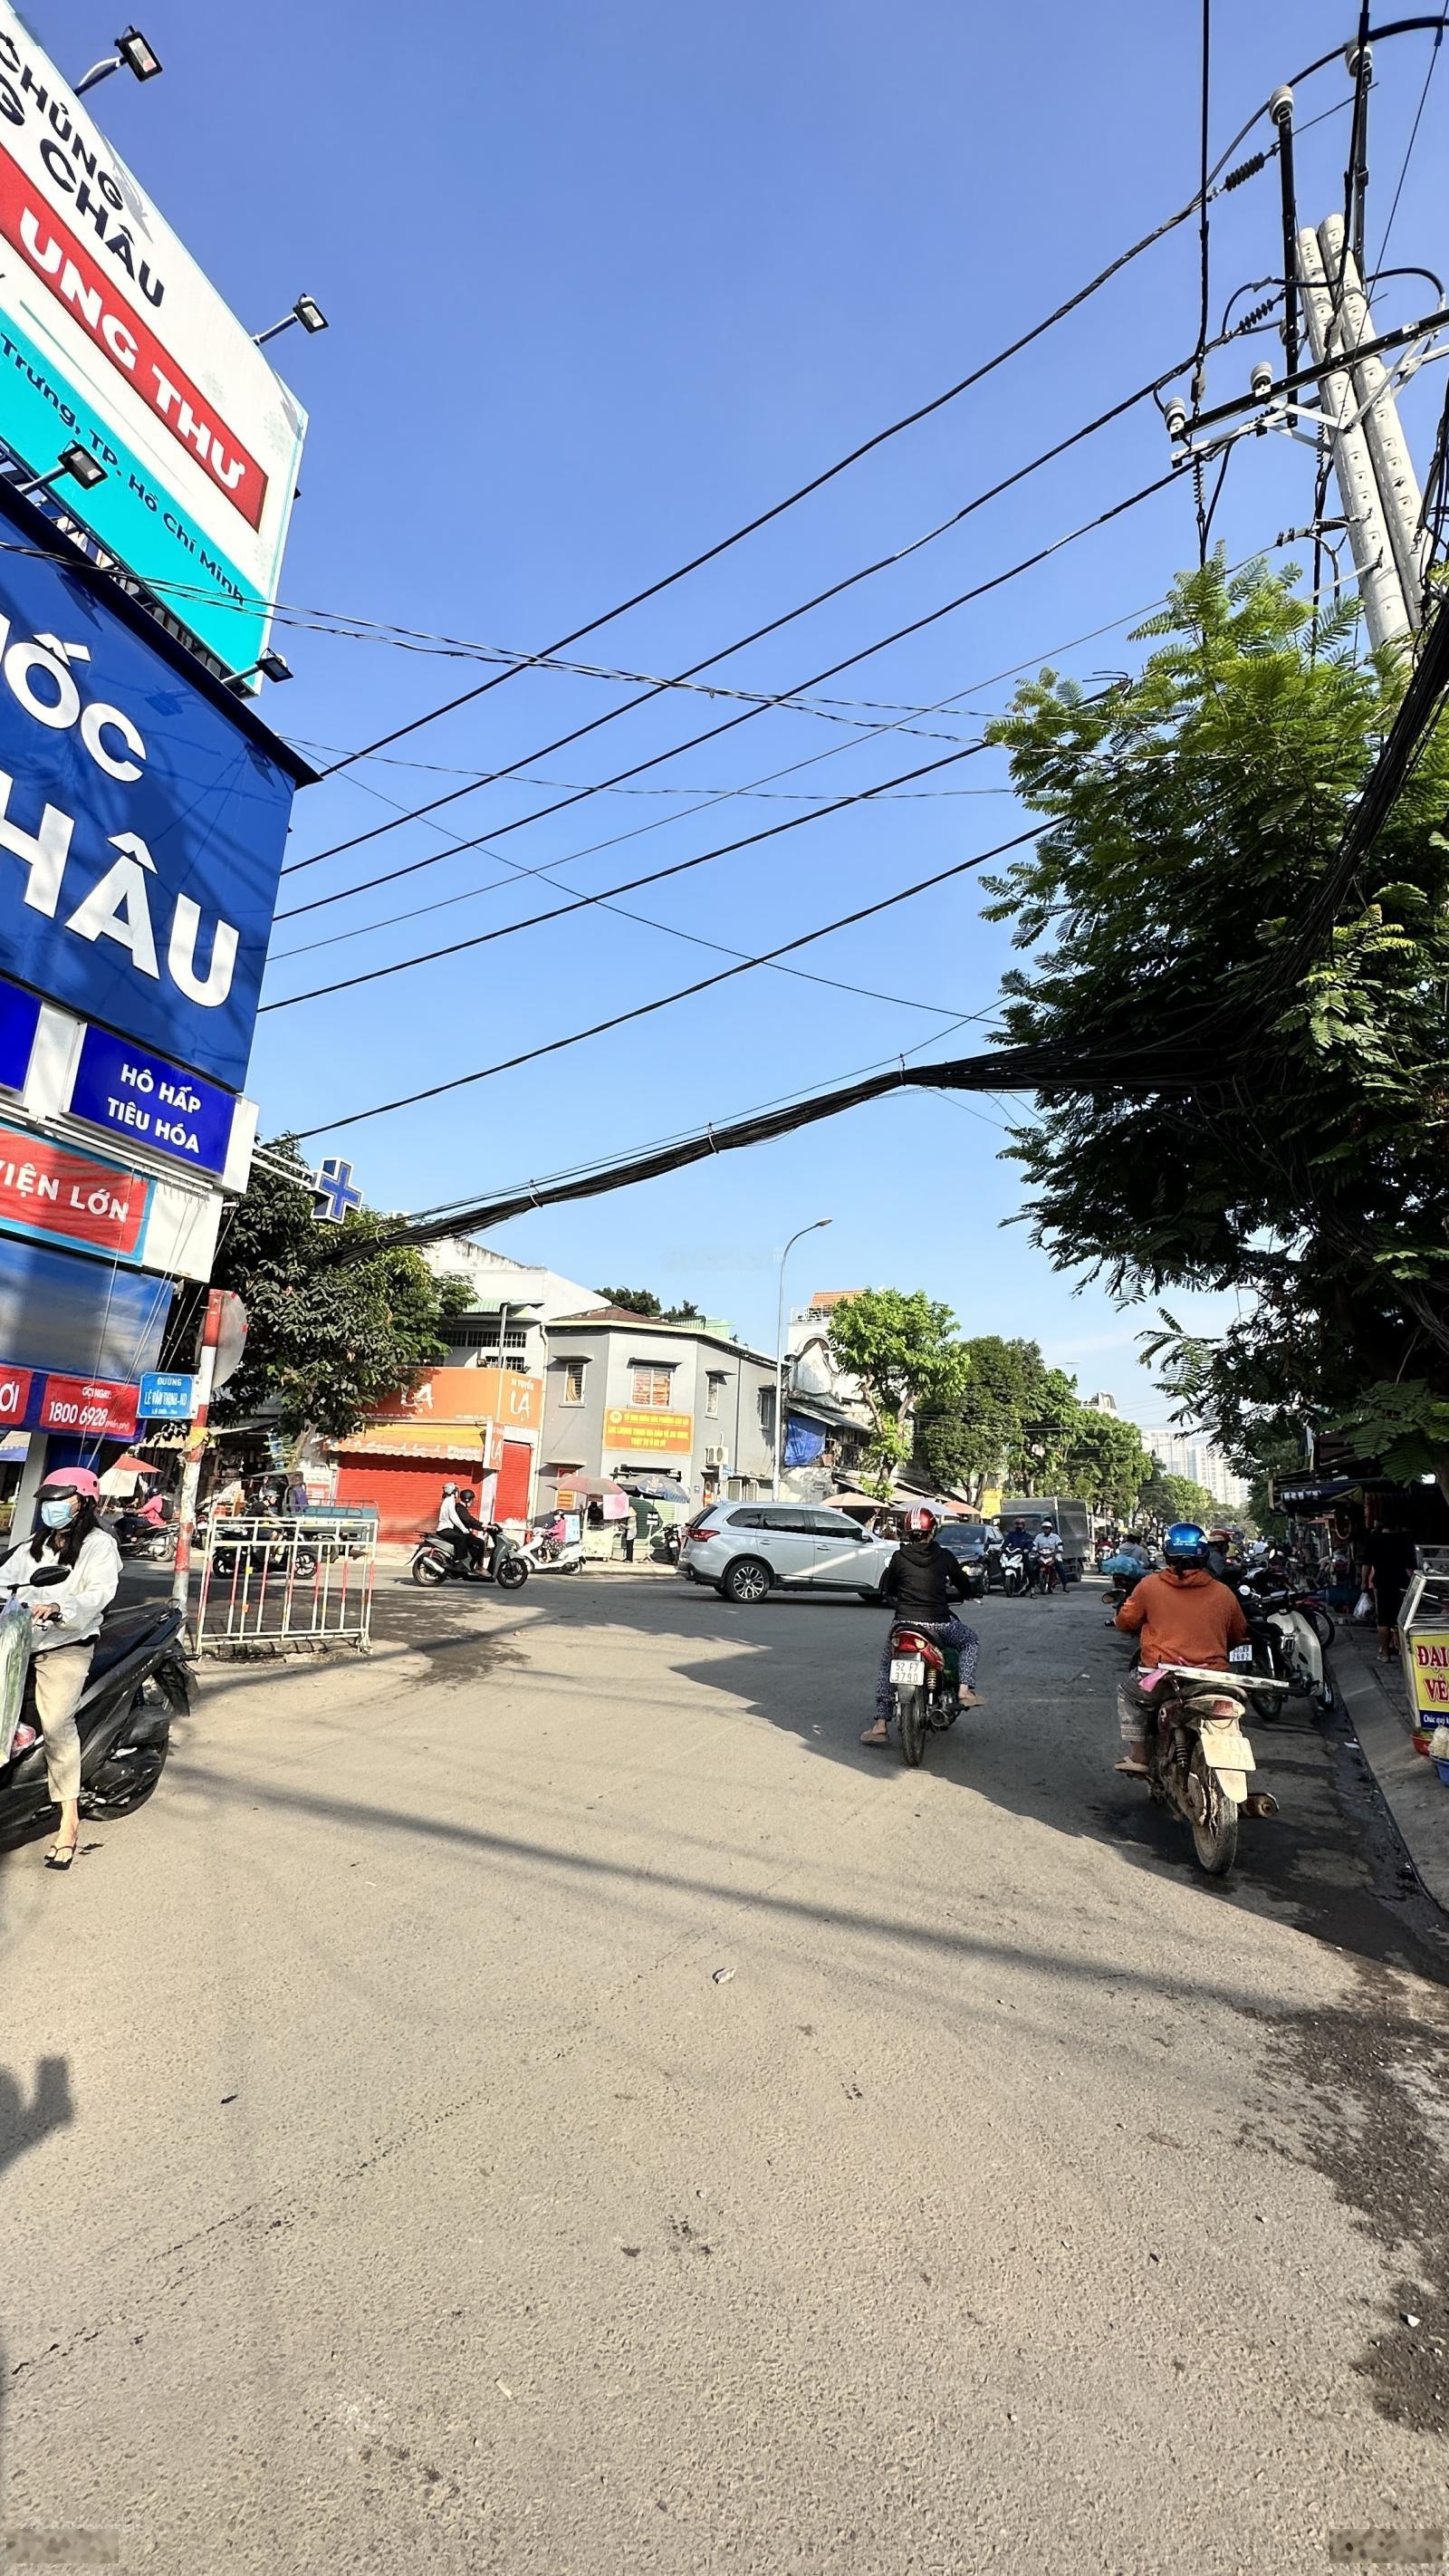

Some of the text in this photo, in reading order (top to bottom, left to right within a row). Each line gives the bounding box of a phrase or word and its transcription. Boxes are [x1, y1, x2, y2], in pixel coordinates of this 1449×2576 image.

[40, 139, 165, 307] CHÂU
[20, 207, 246, 489] UNG THƯ
[1, 332, 82, 435] Trưng,
[129, 474, 158, 513] Hồ
[163, 513, 197, 553] Chí
[199, 550, 245, 606] Minh
[0, 612, 146, 783] ỐC
[120, 1063, 201, 1113] HÔ HẤP
[108, 1097, 200, 1153] TIÊU HÓA
[70, 1186, 130, 1223] LỚN
[48, 1401, 79, 1425] 1800
[79, 1406, 109, 1427] 6928
[1417, 1645, 1449, 1670] ĐẠI
